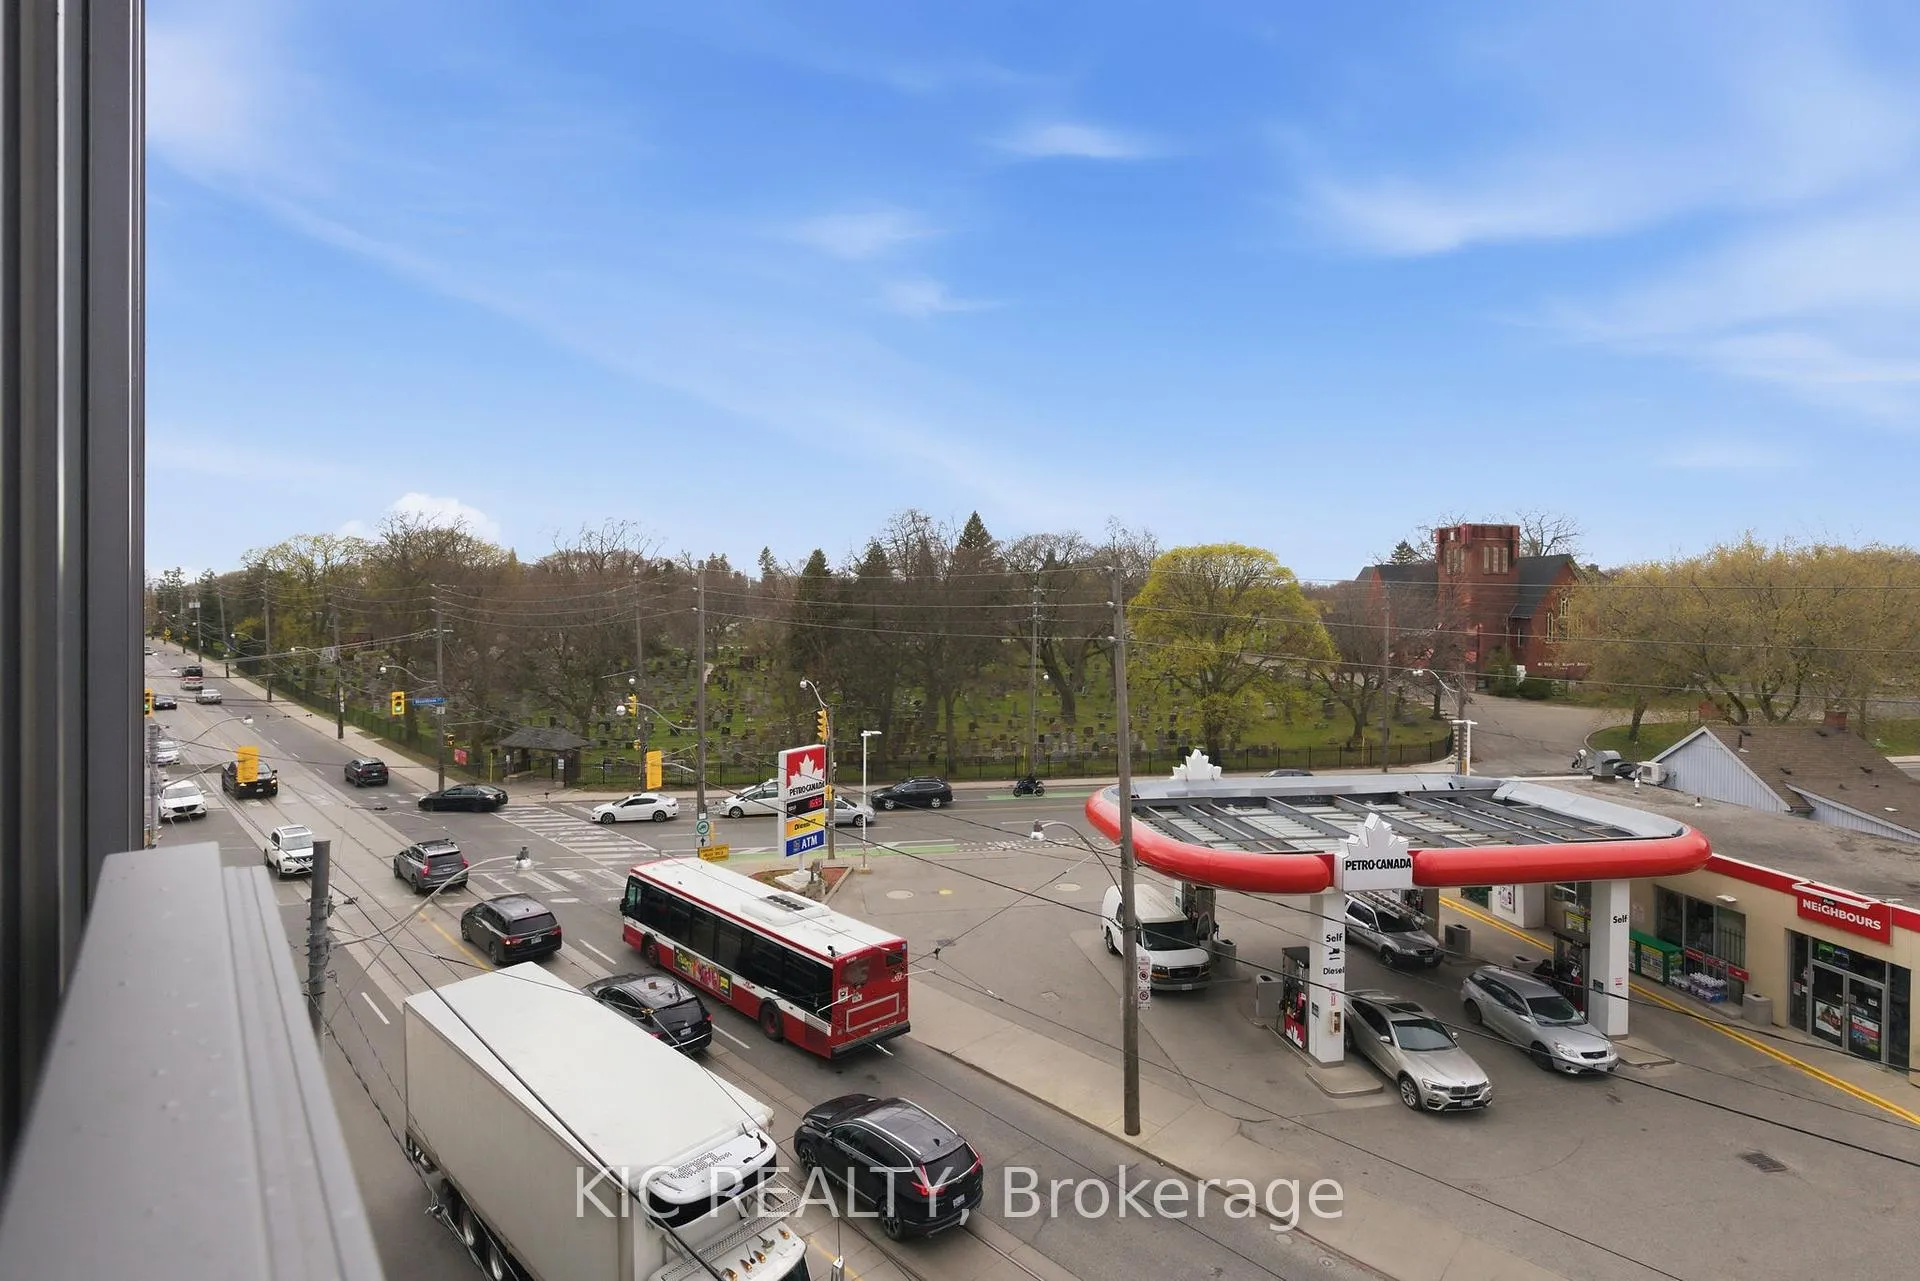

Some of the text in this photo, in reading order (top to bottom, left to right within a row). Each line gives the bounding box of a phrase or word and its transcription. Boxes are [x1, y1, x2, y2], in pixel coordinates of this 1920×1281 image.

[801, 835, 818, 850] ATM
[1612, 914, 1628, 924] Self
[1325, 932, 1343, 943] Self
[1323, 966, 1345, 976] Diesel
